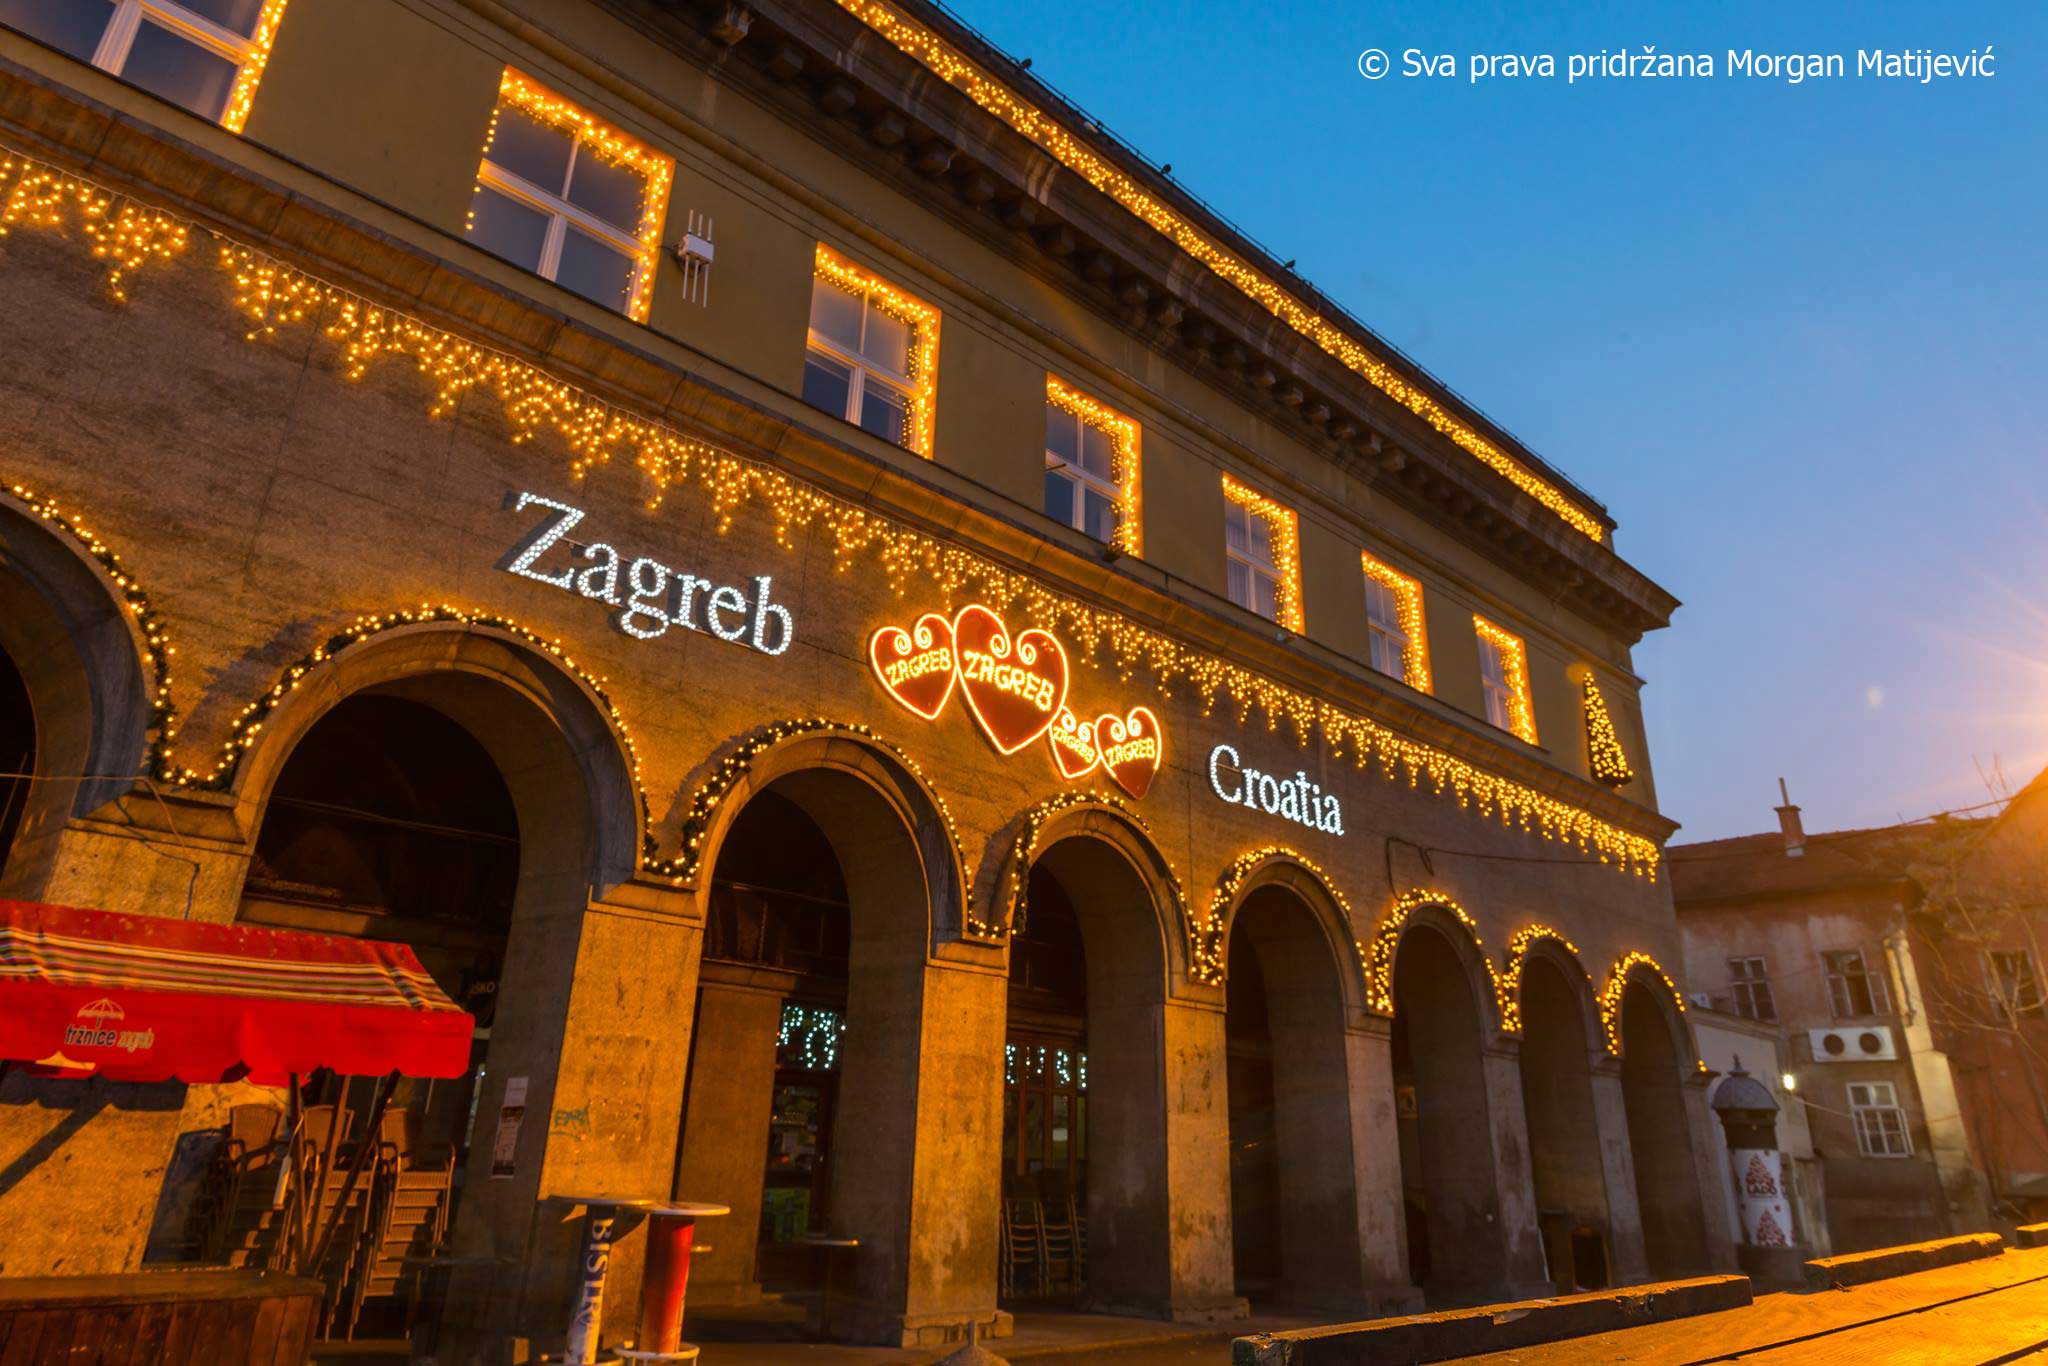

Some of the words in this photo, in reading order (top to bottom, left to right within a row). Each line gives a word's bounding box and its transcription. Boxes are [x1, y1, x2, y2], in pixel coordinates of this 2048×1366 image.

[507, 491, 794, 657] Zagreb
[885, 648, 952, 687] ZAGREB
[963, 650, 1056, 712] ZAGREB
[1052, 725, 1096, 764] ZAGREB
[1104, 737, 1156, 768] ZAGREB
[1208, 743, 1345, 838] Croatia
[64, 1024, 118, 1048] tržnice
